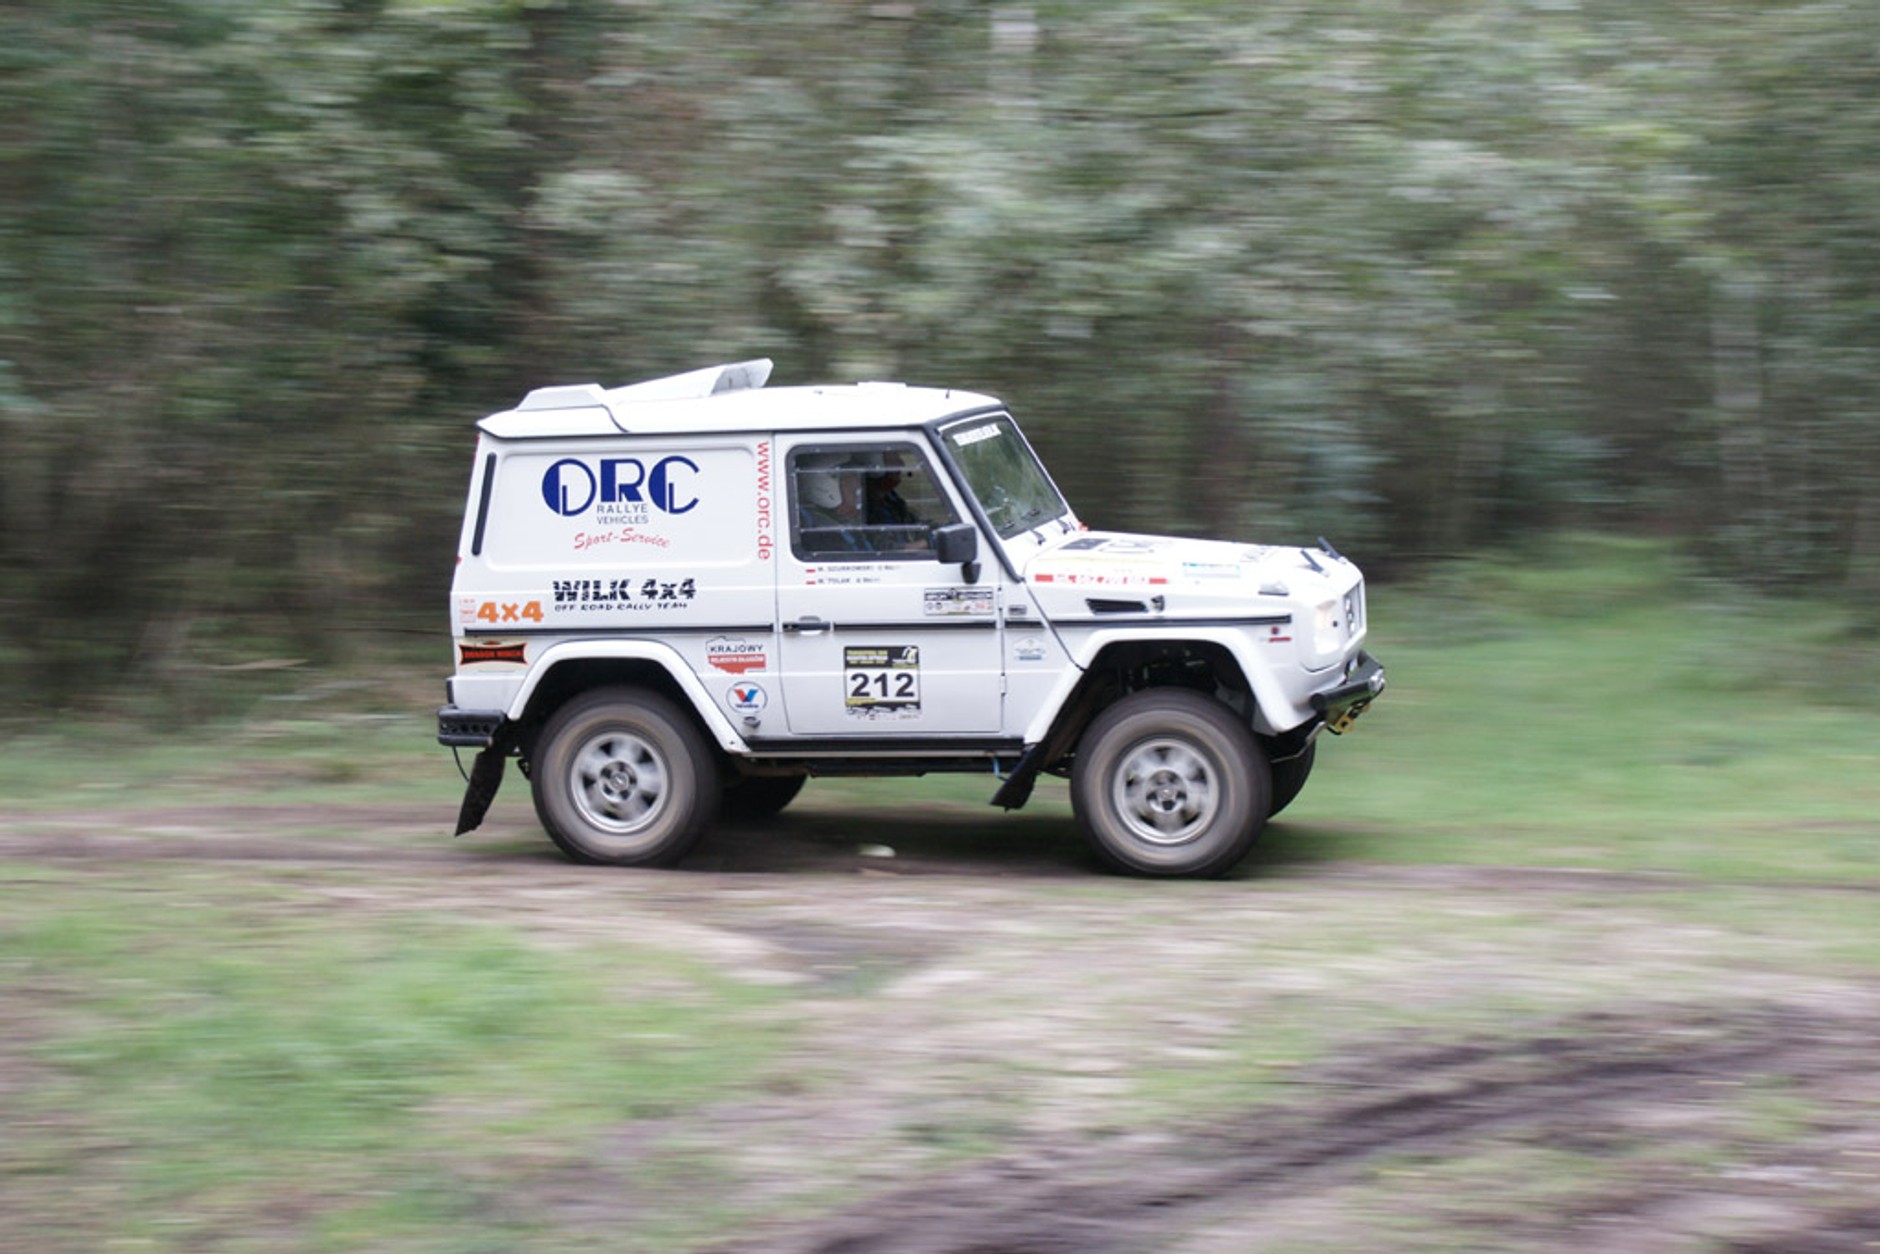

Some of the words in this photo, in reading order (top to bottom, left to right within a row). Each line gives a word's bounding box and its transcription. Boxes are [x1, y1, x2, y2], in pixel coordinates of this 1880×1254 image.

[542, 456, 700, 517] ORC
[597, 503, 648, 514] RALLYE
[757, 441, 774, 560] www.orc.de
[597, 515, 649, 525] VEHICLES
[574, 528, 670, 550] Sport-Service
[552, 579, 631, 602] WILK
[640, 578, 697, 601] 4x4
[477, 601, 545, 623] 4x4
[554, 604, 576, 612] OFF
[580, 603, 614, 611] ROAD
[616, 603, 653, 611] RALLY
[657, 602, 689, 610] TEAM
[709, 643, 764, 653] KRAJOWY
[850, 672, 915, 698] 212
